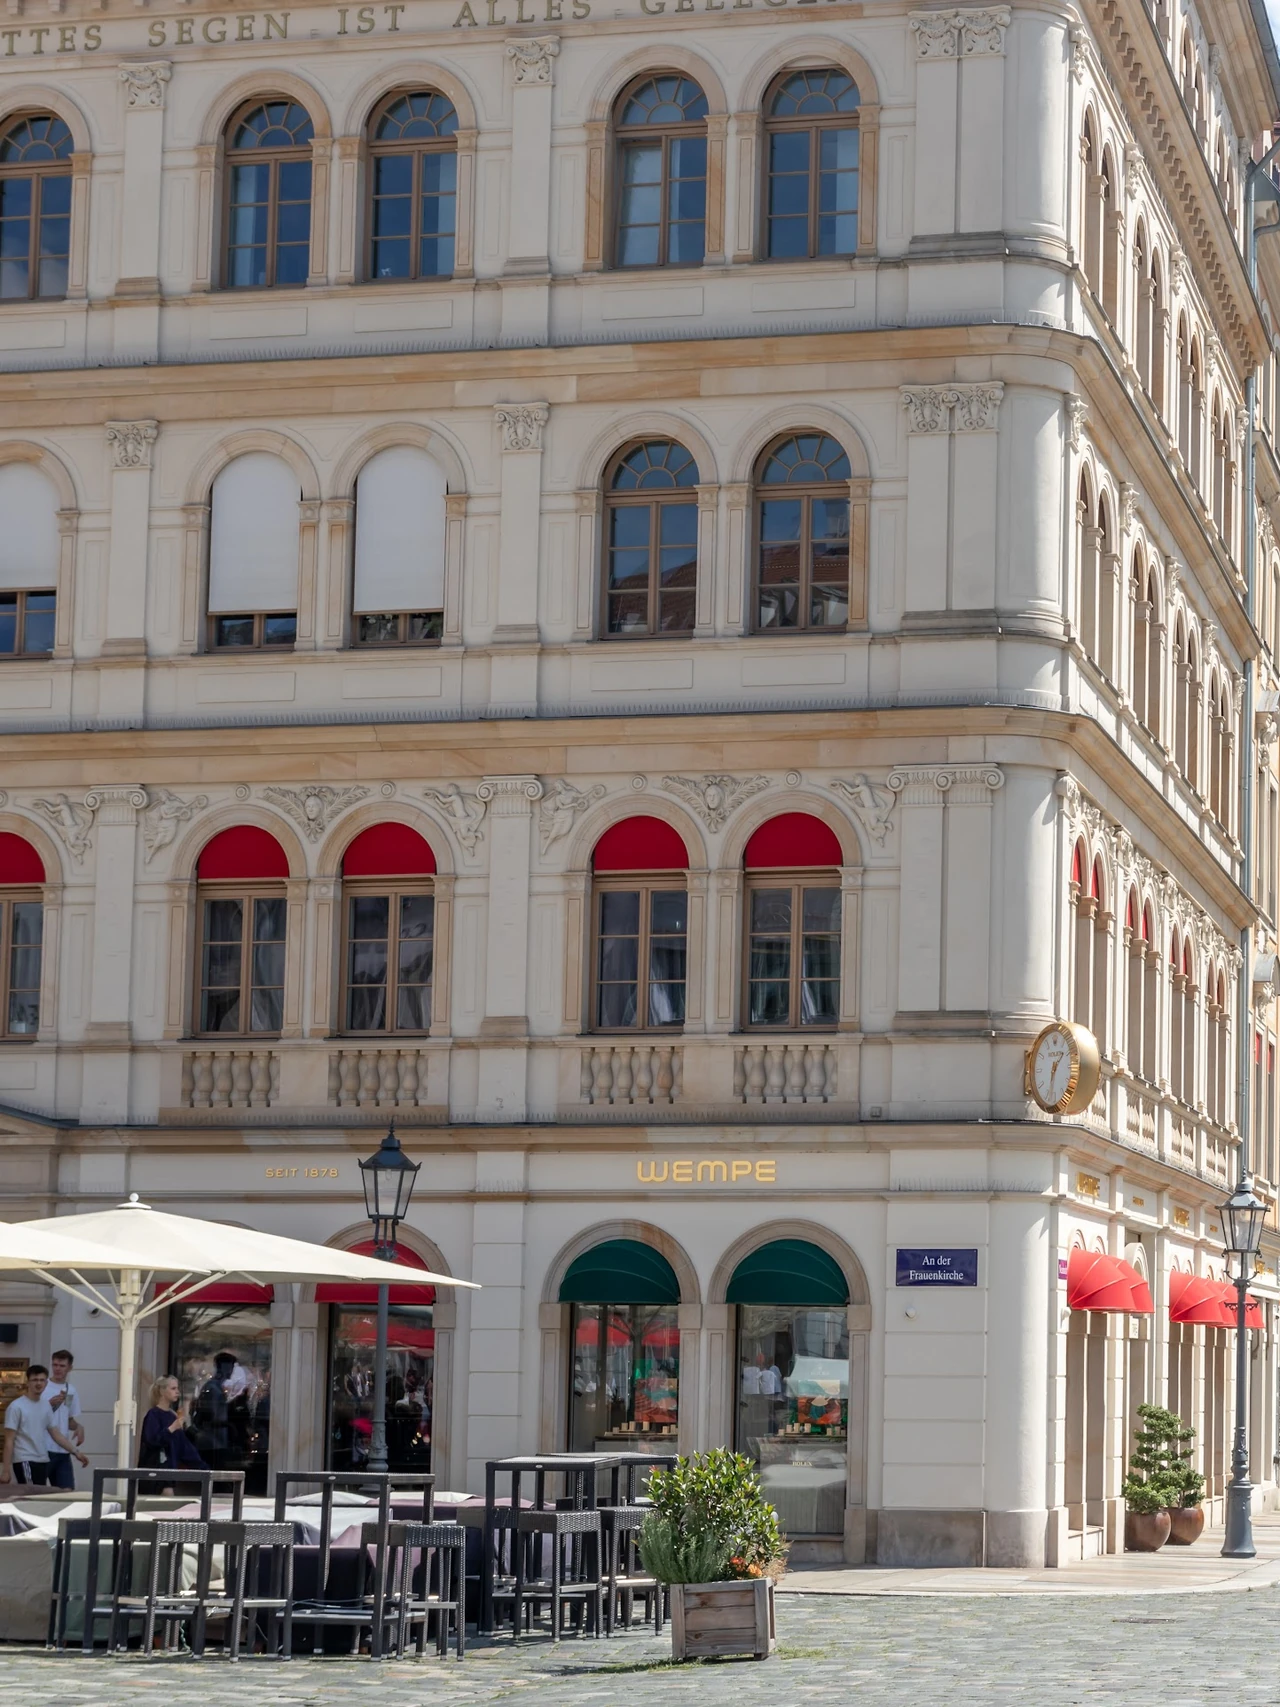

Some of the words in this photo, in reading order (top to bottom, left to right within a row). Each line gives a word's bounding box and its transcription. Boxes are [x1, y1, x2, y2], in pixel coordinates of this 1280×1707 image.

[148, 13, 290, 47] SEGEN
[337, 5, 405, 35] IST
[453, 0, 592, 27] ALLES
[265, 1168, 298, 1178] SEIT
[304, 1168, 338, 1178] 1878
[637, 1160, 776, 1182] WEMPE
[922, 1255, 935, 1266] An
[937, 1255, 951, 1266] der
[909, 1270, 964, 1280] Frauenkirche
